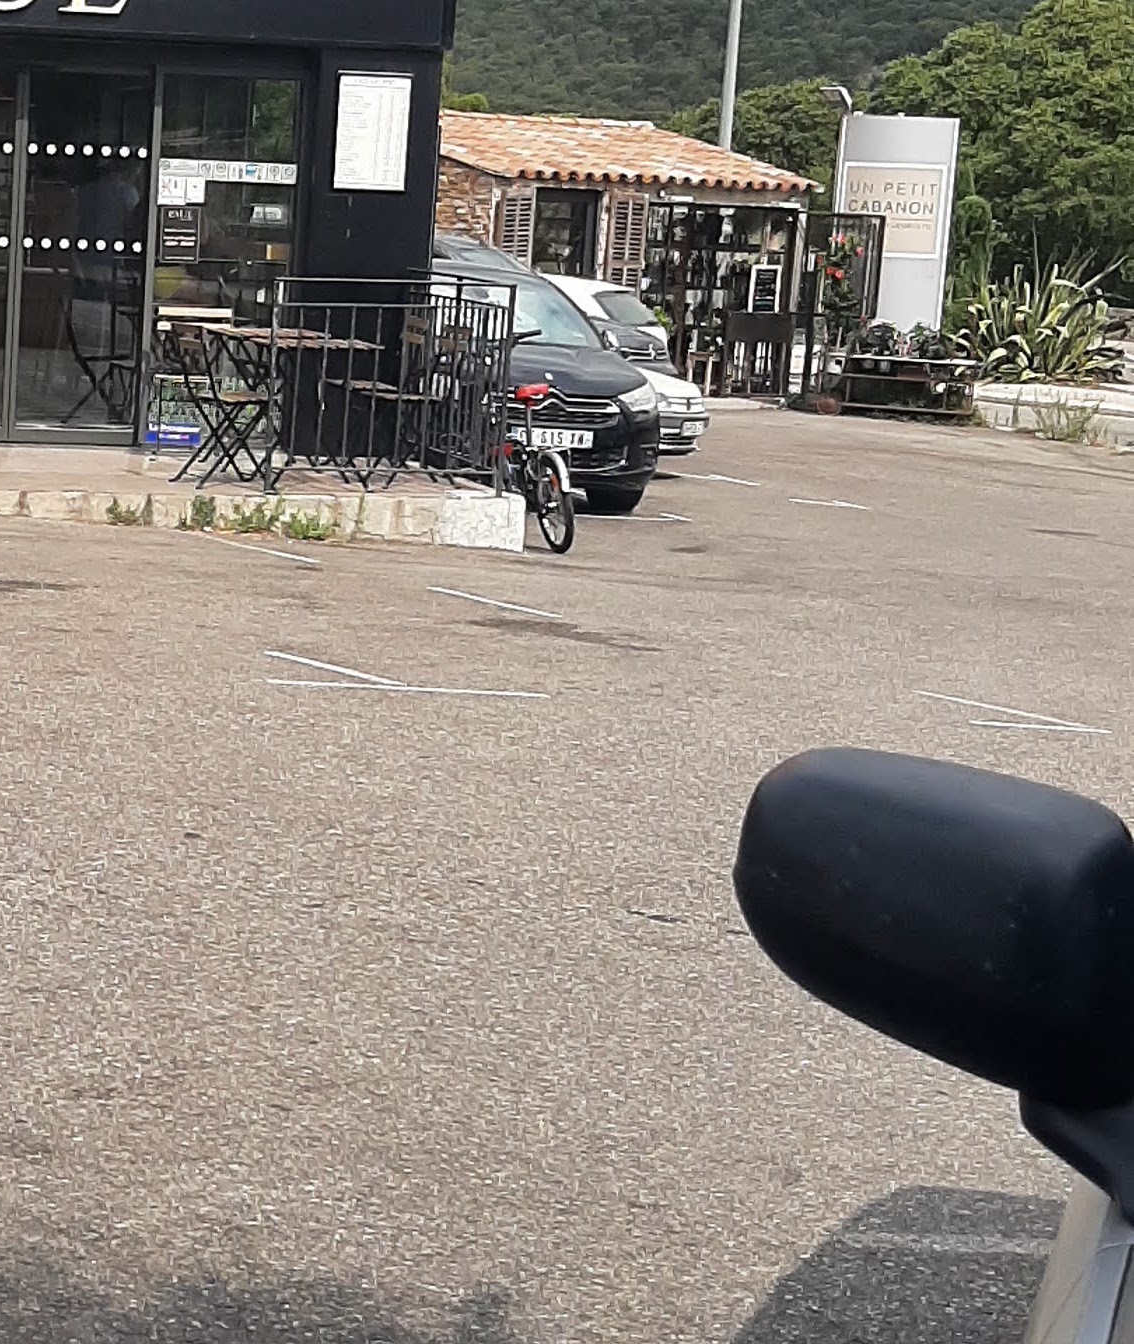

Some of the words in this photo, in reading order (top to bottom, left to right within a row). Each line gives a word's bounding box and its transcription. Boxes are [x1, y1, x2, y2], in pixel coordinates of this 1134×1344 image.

[849, 179, 874, 195] UN
[883, 182, 938, 196] PETIT
[848, 199, 934, 215] CABANON
